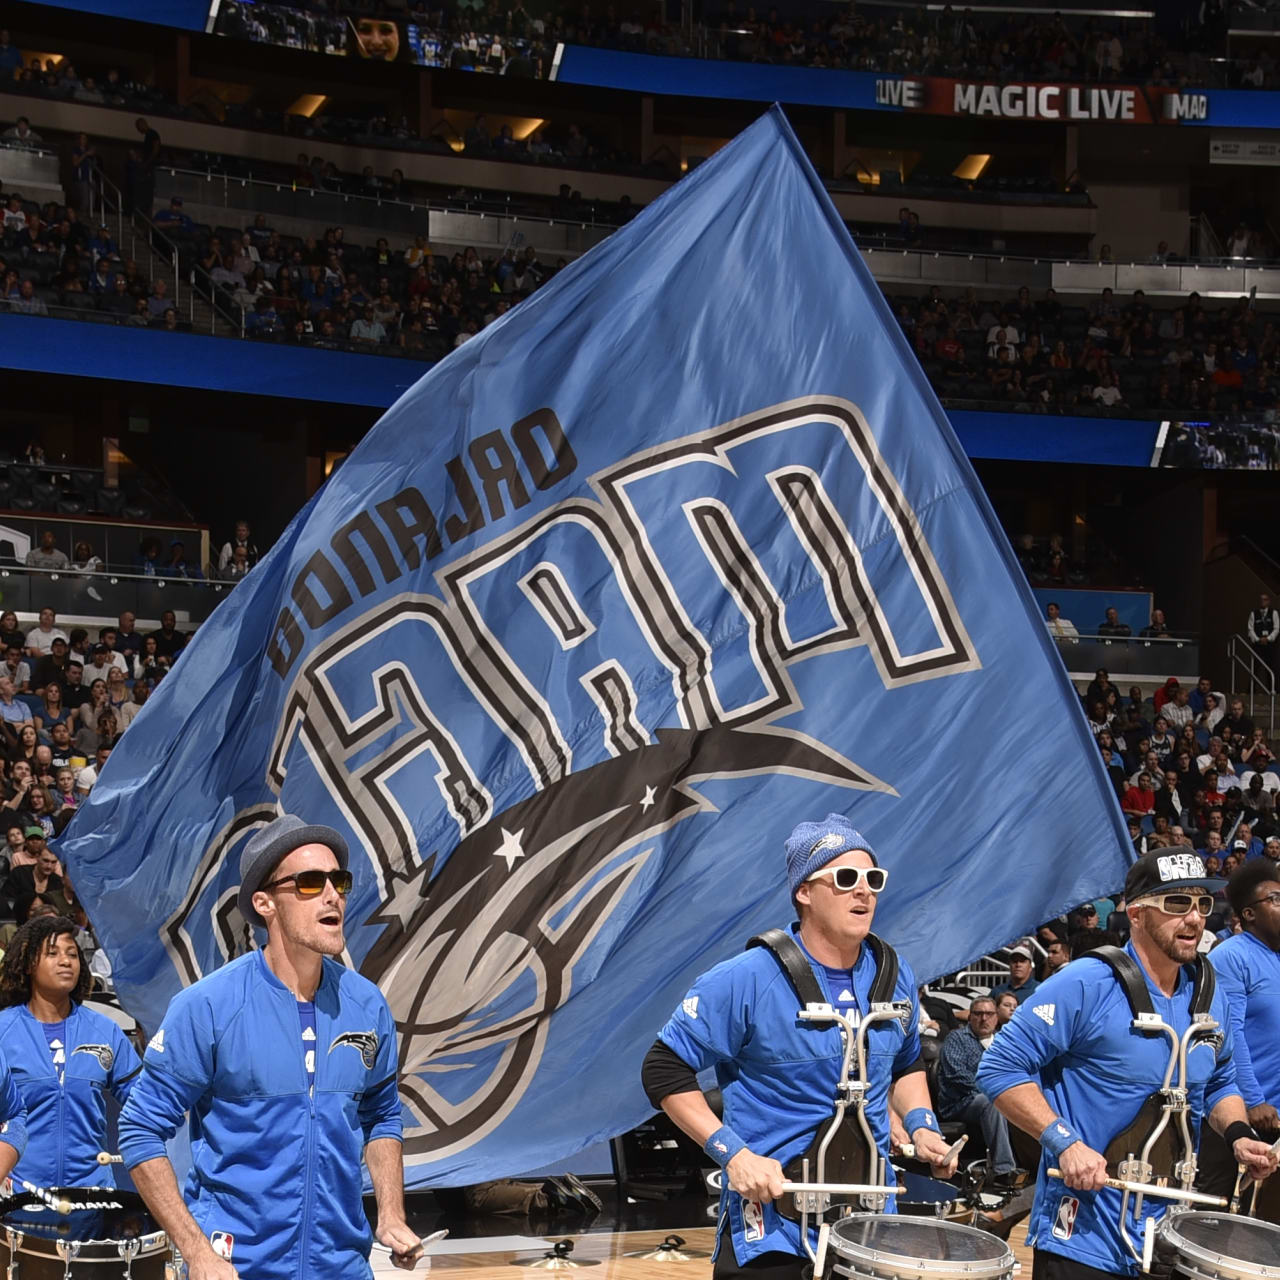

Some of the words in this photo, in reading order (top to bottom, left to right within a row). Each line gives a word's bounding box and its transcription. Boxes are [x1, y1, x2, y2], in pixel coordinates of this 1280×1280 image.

[954, 83, 1060, 119] MAGIC
[1070, 87, 1135, 119] LIVE
[45, 1199, 124, 1212] YMAHA
